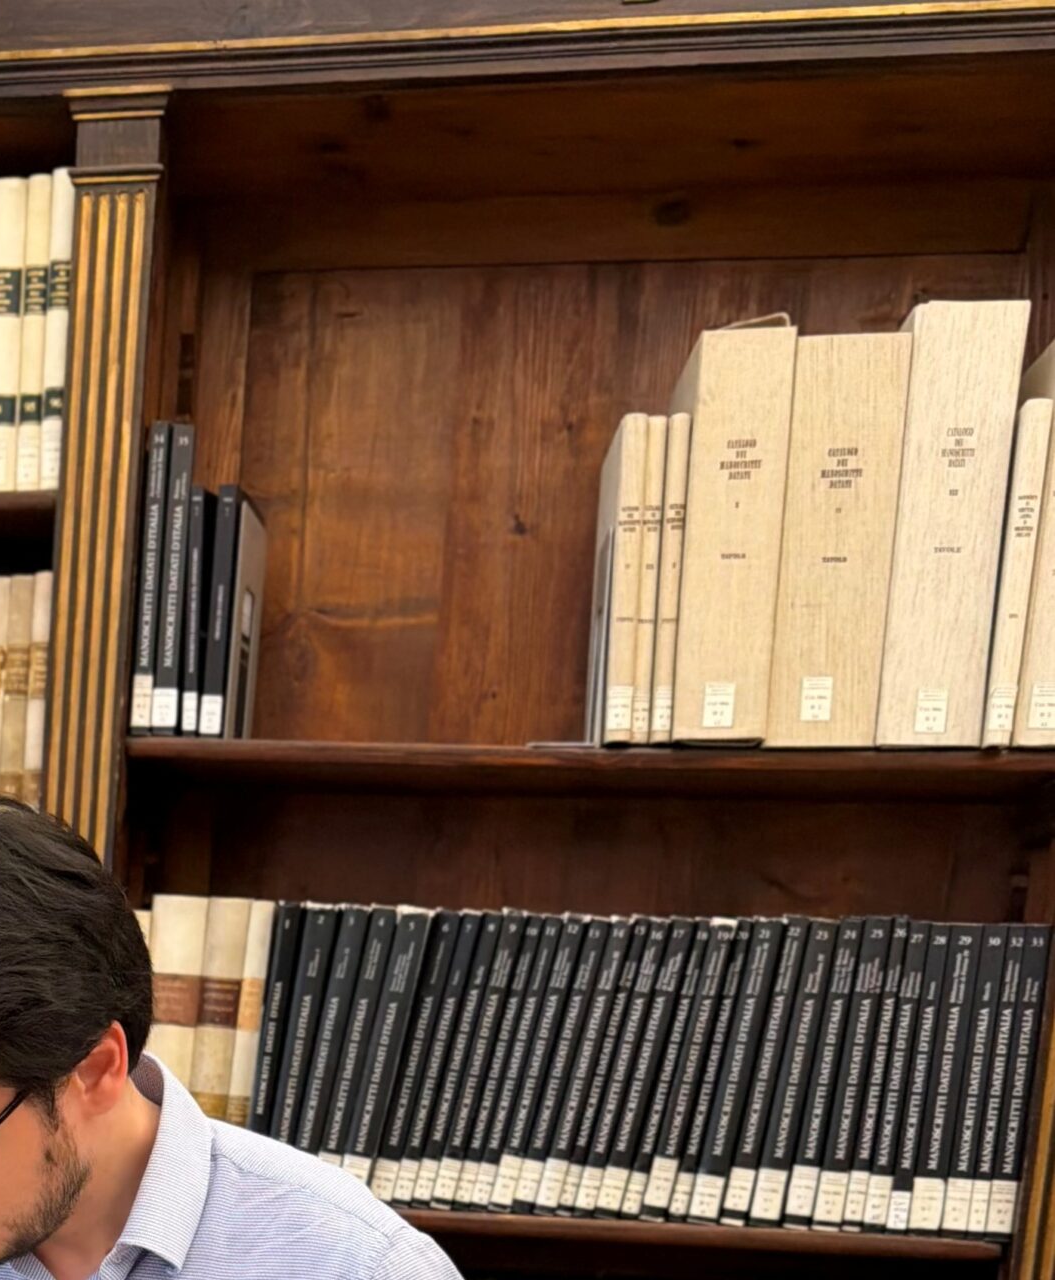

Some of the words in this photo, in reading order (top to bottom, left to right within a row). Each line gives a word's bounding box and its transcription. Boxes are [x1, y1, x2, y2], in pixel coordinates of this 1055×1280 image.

[147, 504, 159, 549] D'ITALIA
[171, 505, 183, 551] D'ITALIA
[145, 552, 156, 591] DATATI
[168, 553, 180, 592] DATATI
[139, 593, 153, 666] MANOSCRITTI
[163, 594, 177, 667] MANOSCRITTI
[317, 916, 325, 924] 2
[442, 924, 449, 932] 6
[465, 924, 471, 932] 7
[509, 924, 516, 933] 9
[567, 925, 579, 934] 12
[613, 929, 625, 938] 14
[651, 931, 662, 940] 16
[673, 929, 684, 938] 17
[697, 931, 708, 940] 18
[759, 930, 770, 938] 21
[787, 928, 801, 936] 22
[815, 931, 828, 940] 23
[844, 930, 856, 939] 24
[870, 929, 883, 938] 25
[895, 929, 906, 937] 26
[911, 934, 923, 942] 27
[933, 936, 946, 945] 28
[958, 936, 972, 945] 29
[988, 937, 1000, 946] 30
[1011, 938, 1023, 947] 32
[1031, 938, 1043, 946] 33
[296, 995, 312, 1037] D'ITALIA
[826, 999, 843, 1044] D'ITALIA
[855, 999, 871, 1044] D'ITALIA
[879, 998, 895, 1043] D'ITALIA
[896, 1004, 912, 1049] D'ITALIA
[919, 1006, 935, 1052] D'ITALIA
[945, 1006, 960, 1052] D'ITALIA
[975, 1008, 990, 1054] D'ITALIA
[998, 1009, 1013, 1055] D'ITALIA
[1020, 1009, 1034, 1055] D'ITALIA
[290, 1040, 304, 1076] DATATI
[300, 1079, 322, 1148] MANOSCRITTI
[314, 1042, 330, 1078] DATATI
[322, 997, 339, 1039] D'ITALIA
[327, 1081, 350, 1149] MANOSCRITTI
[342, 1043, 358, 1079] DATATI
[350, 999, 368, 1041] D'ITALIA
[355, 1084, 379, 1152] MANOSCRITTI
[371, 1047, 388, 1082] DATATI
[380, 1002, 398, 1044] D'ITALIA
[389, 1078, 414, 1146] MANOSCRITTI
[406, 1041, 423, 1076] DATATI
[415, 997, 433, 1038] D'ITALIA
[411, 1079, 436, 1147] MANOSCRITTI
[428, 1042, 445, 1077] DATATI
[437, 998, 455, 1039] D'ITALIA
[433, 1072, 458, 1141] MANOSCRITTI
[450, 1034, 467, 1070] DATATI
[460, 990, 479, 1032] D'ITALIA
[452, 1077, 478, 1146] MANOSCRITTI
[470, 1039, 487, 1075] DATATI
[480, 994, 499, 1037] D'ITALIA
[471, 1080, 497, 1148] MANOSCRITTI
[489, 1042, 507, 1078] DATATI
[499, 997, 518, 1039] D'ITALIA
[489, 1080, 515, 1149] MANOSCRITTI
[507, 1042, 525, 1078] DATATI
[518, 997, 537, 1039] D'ITALIA
[510, 1079, 536, 1148] MANOSCRITTI
[528, 1041, 546, 1077] DATATI
[538, 996, 557, 1038] D'ITALIA
[533, 1079, 560, 1148] MANOSCRITTI
[552, 1041, 570, 1077] DATATI
[562, 996, 582, 1038] D'ITALIA
[557, 1079, 584, 1149] MANOSCRITTI
[576, 1041, 594, 1078] DATATI
[586, 996, 606, 1039] D'ITALIA
[576, 1077, 603, 1146] MANOSCRITTI
[596, 1038, 614, 1075] DATATI
[606, 993, 626, 1036] D'ITALIA
[595, 1083, 622, 1153] MANOSCRITTI
[614, 1045, 632, 1081] DATATI
[625, 999, 644, 1042] D'ITALIA
[616, 1081, 643, 1151] MANOSCRITTI
[635, 1042, 653, 1079] DATATI
[646, 997, 665, 1040] D'ITALIA
[642, 1082, 669, 1152] MANOSCRITTI
[661, 1044, 679, 1080] DATATI
[671, 998, 691, 1041] D'ITALIA
[665, 1084, 691, 1155] MANOSCRITTI
[683, 1045, 701, 1082] DATATI
[693, 999, 712, 1043] D'ITALIA
[687, 1084, 713, 1155] MANOSCRITTI
[705, 1045, 722, 1082] DATATI
[714, 999, 733, 1043] D'ITALIA
[713, 1084, 737, 1156] MANOSCRITTI
[729, 1045, 746, 1082] DATATI
[738, 998, 756, 1042] D'ITALIA
[742, 1082, 766, 1153] MANOSCRITTI
[758, 1042, 775, 1080] DATATI
[767, 995, 785, 1040] D'ITALIA
[774, 1086, 797, 1158] MANOSCRITTI
[789, 1046, 805, 1084] DATATI
[798, 999, 815, 1044] D'ITALIA
[819, 1046, 834, 1084] DATATI
[848, 1046, 863, 1085] DATATI
[872, 1046, 887, 1084] DATATI
[890, 1052, 905, 1090] DATATI
[913, 1054, 927, 1093] DATATI
[939, 1055, 953, 1093] DATATI
[969, 1056, 983, 1095] DATATI
[992, 1057, 1006, 1096] DATATI
[1014, 1058, 1028, 1097] DATATI
[805, 1086, 827, 1159] MANOSCRITTI
[835, 1086, 856, 1160] MANOSCRITTI
[860, 1086, 880, 1160] MANOSCRITTI
[878, 1092, 898, 1166] MANOSCRITTI
[901, 1095, 921, 1168] MANOSCRITTI
[927, 1095, 947, 1170] MANOSCRITTI
[958, 1097, 977, 1172] MANOSCRITTI
[981, 1098, 1000, 1173] MANOSCRITTI
[1003, 1099, 1022, 1173] MANOSCRITTI
